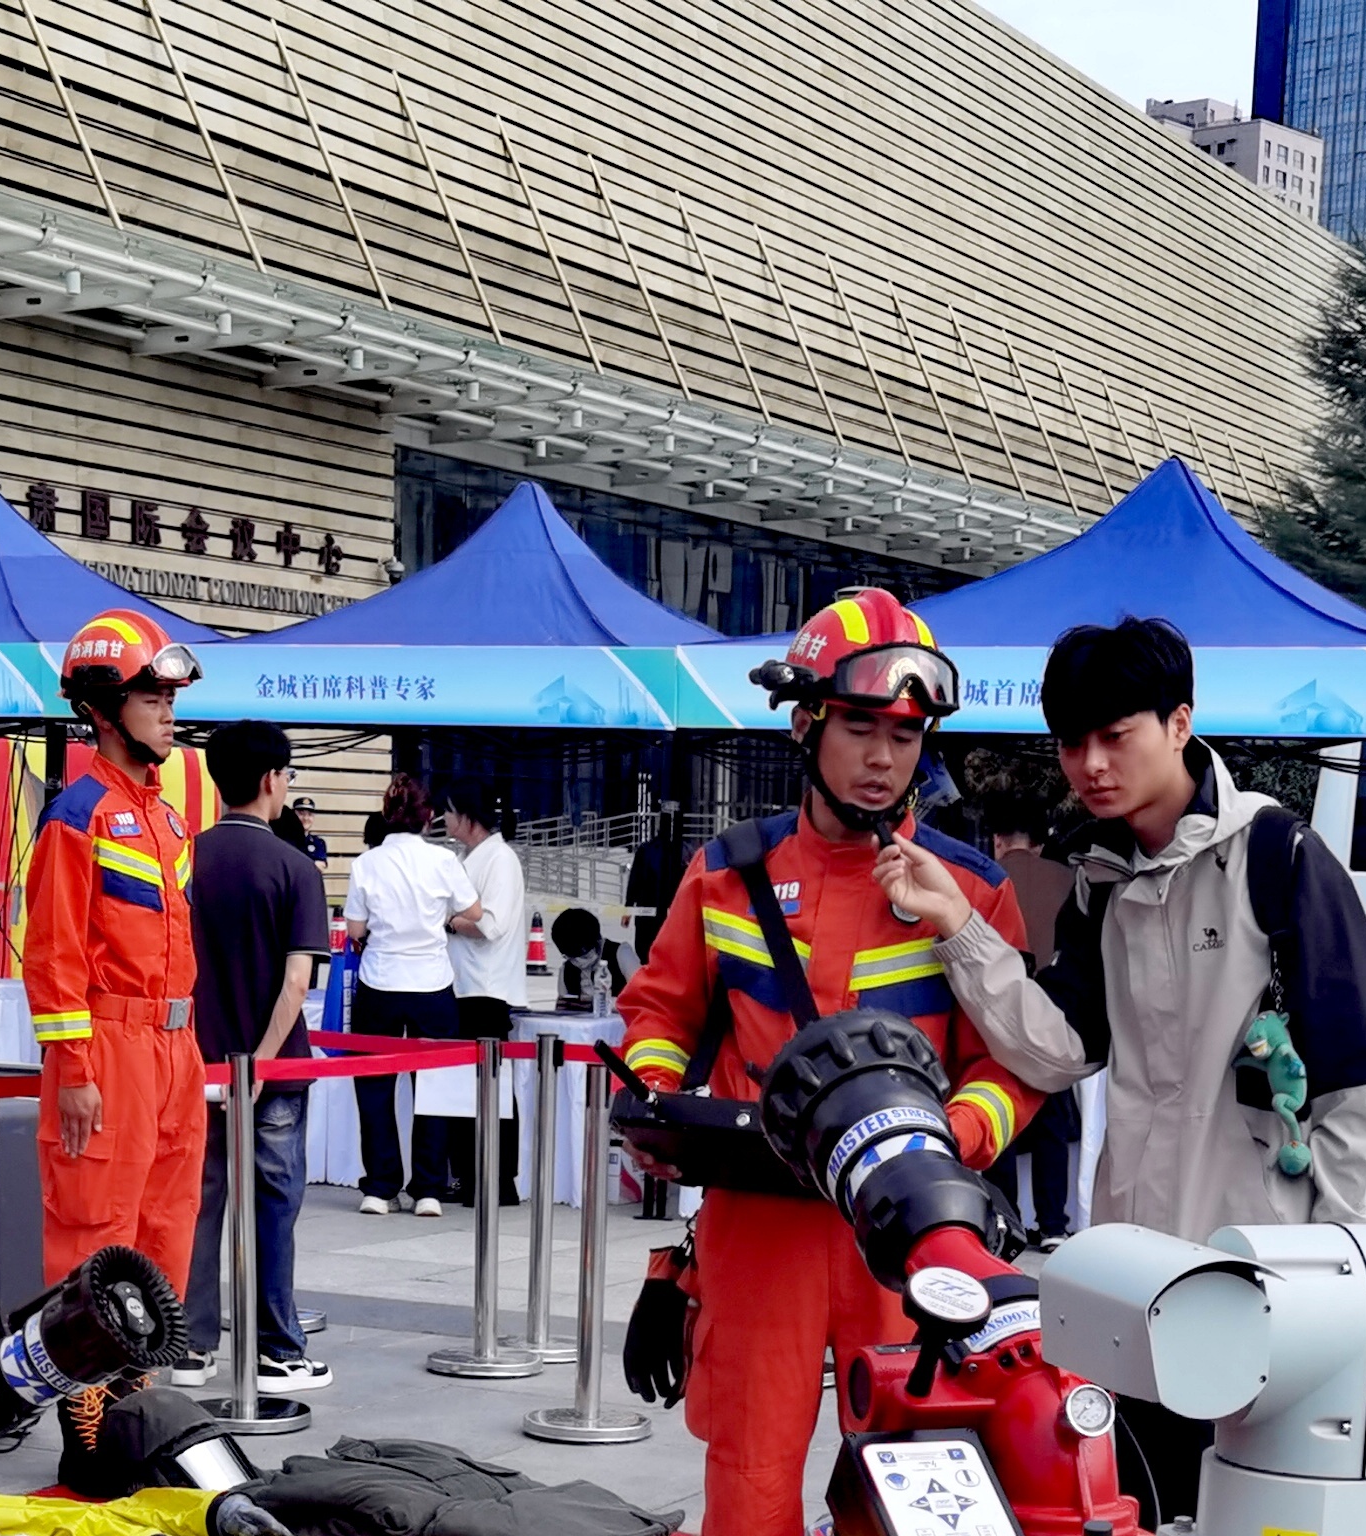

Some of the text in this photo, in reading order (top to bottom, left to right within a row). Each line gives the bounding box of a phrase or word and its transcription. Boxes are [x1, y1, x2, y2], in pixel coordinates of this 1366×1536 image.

[256, 673, 436, 702] 金城首席科普专家
[963, 678, 1043, 707] 城首席
[115, 811, 135, 825] 119
[773, 881, 800, 900] 119
[827, 1112, 893, 1179] MASTER
